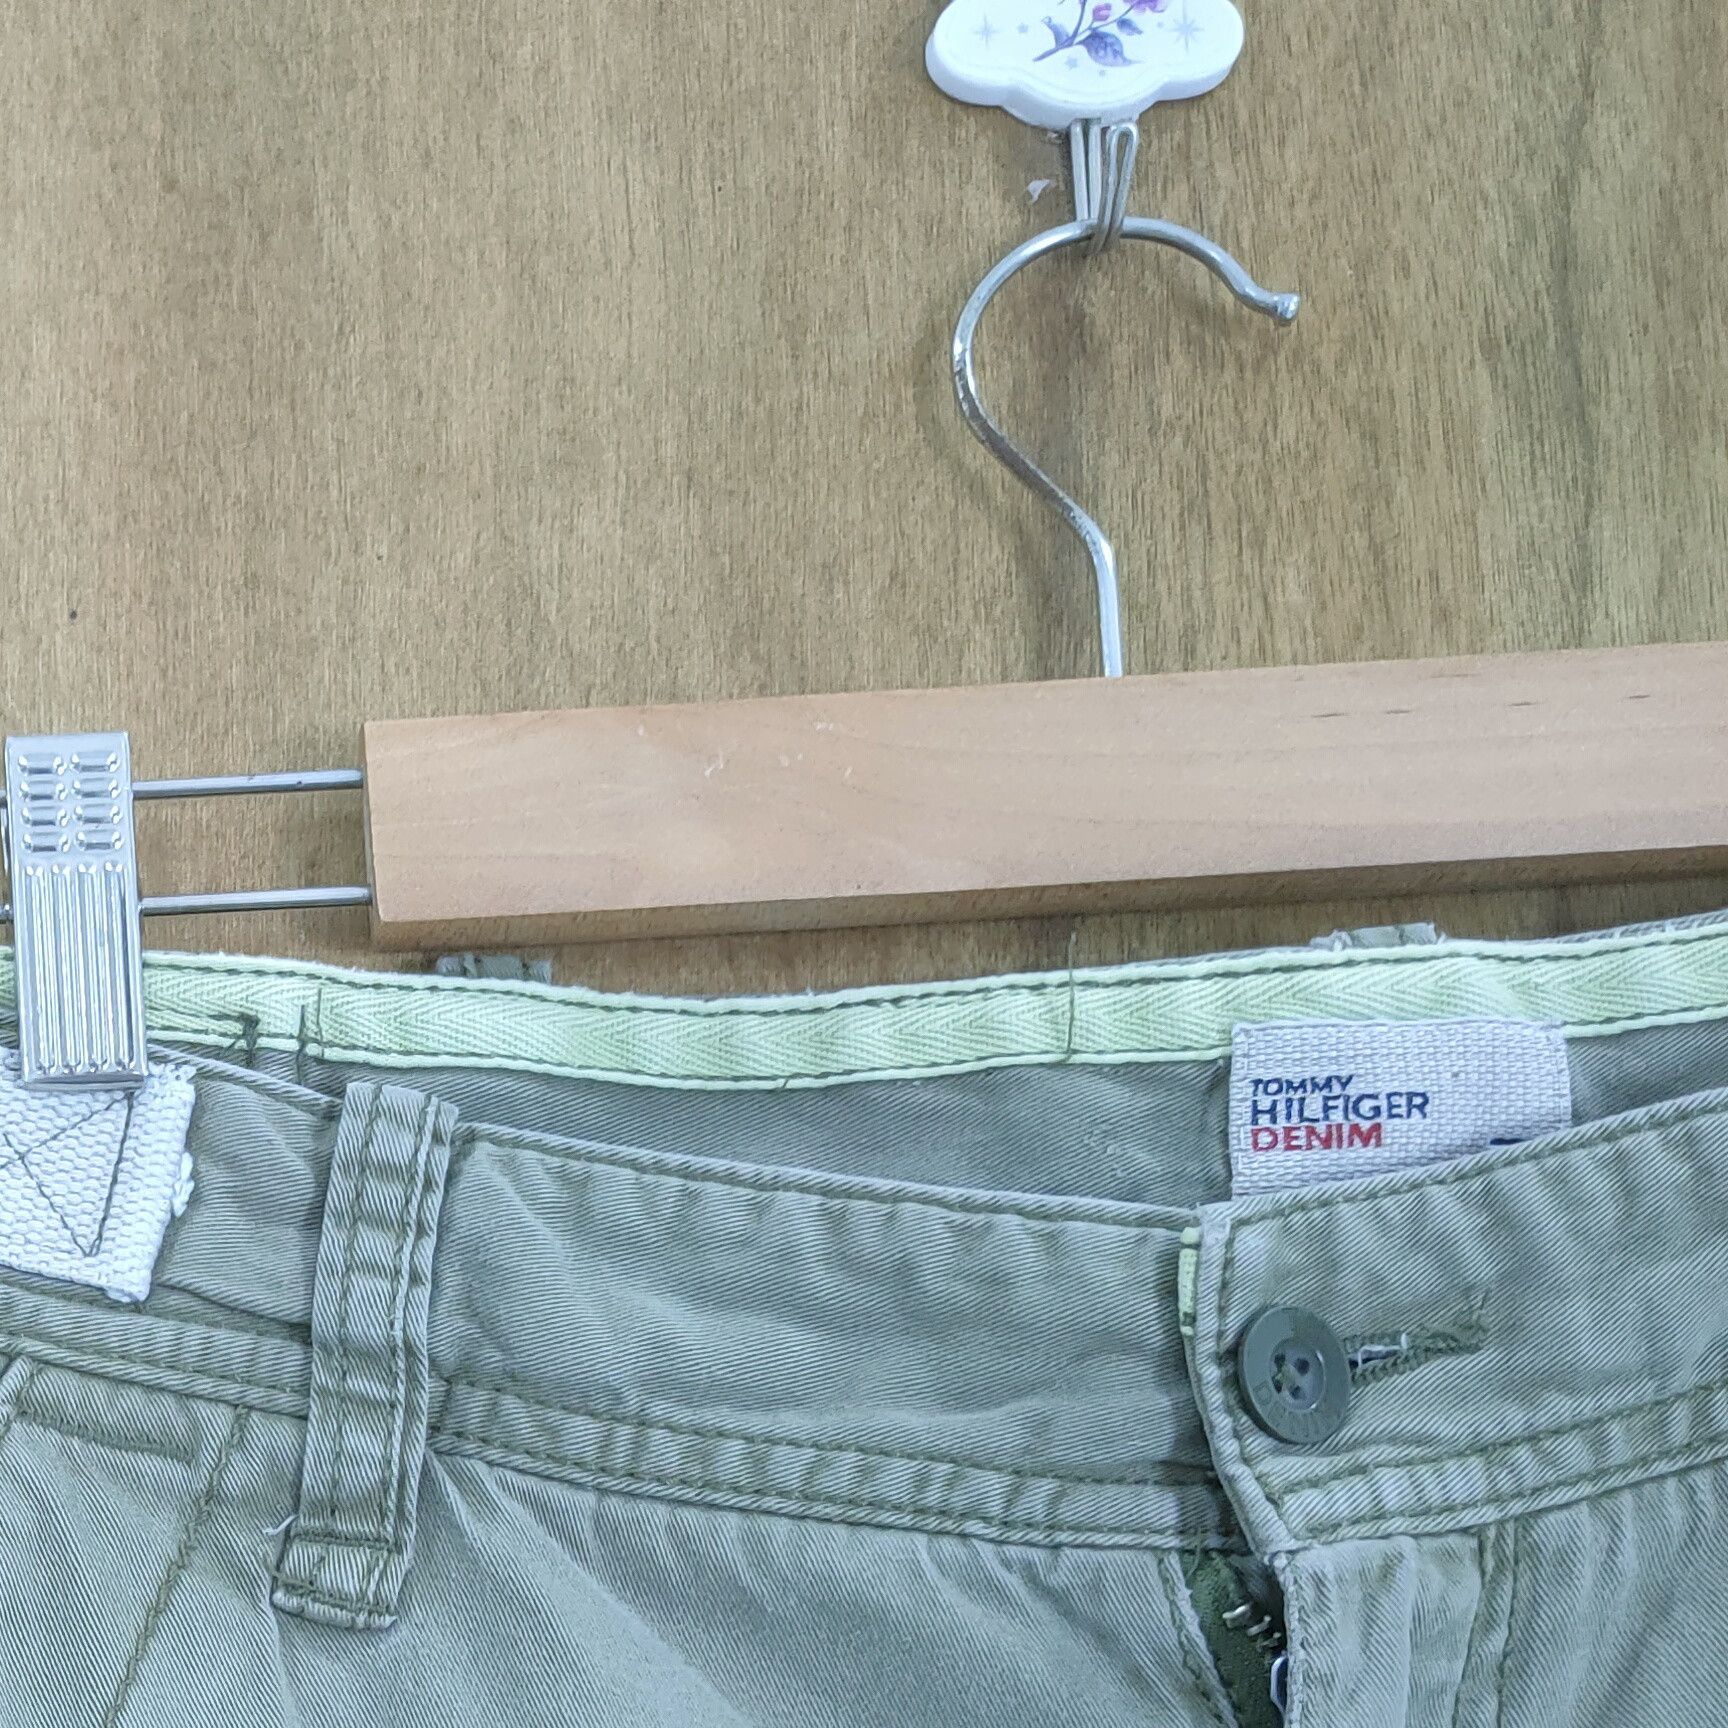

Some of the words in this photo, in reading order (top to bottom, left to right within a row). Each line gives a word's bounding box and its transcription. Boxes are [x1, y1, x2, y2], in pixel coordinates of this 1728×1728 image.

[1250, 1074, 1354, 1097] TOMMY
[1250, 1091, 1429, 1126] HILFIGER
[1251, 1122, 1383, 1152] DENIM
